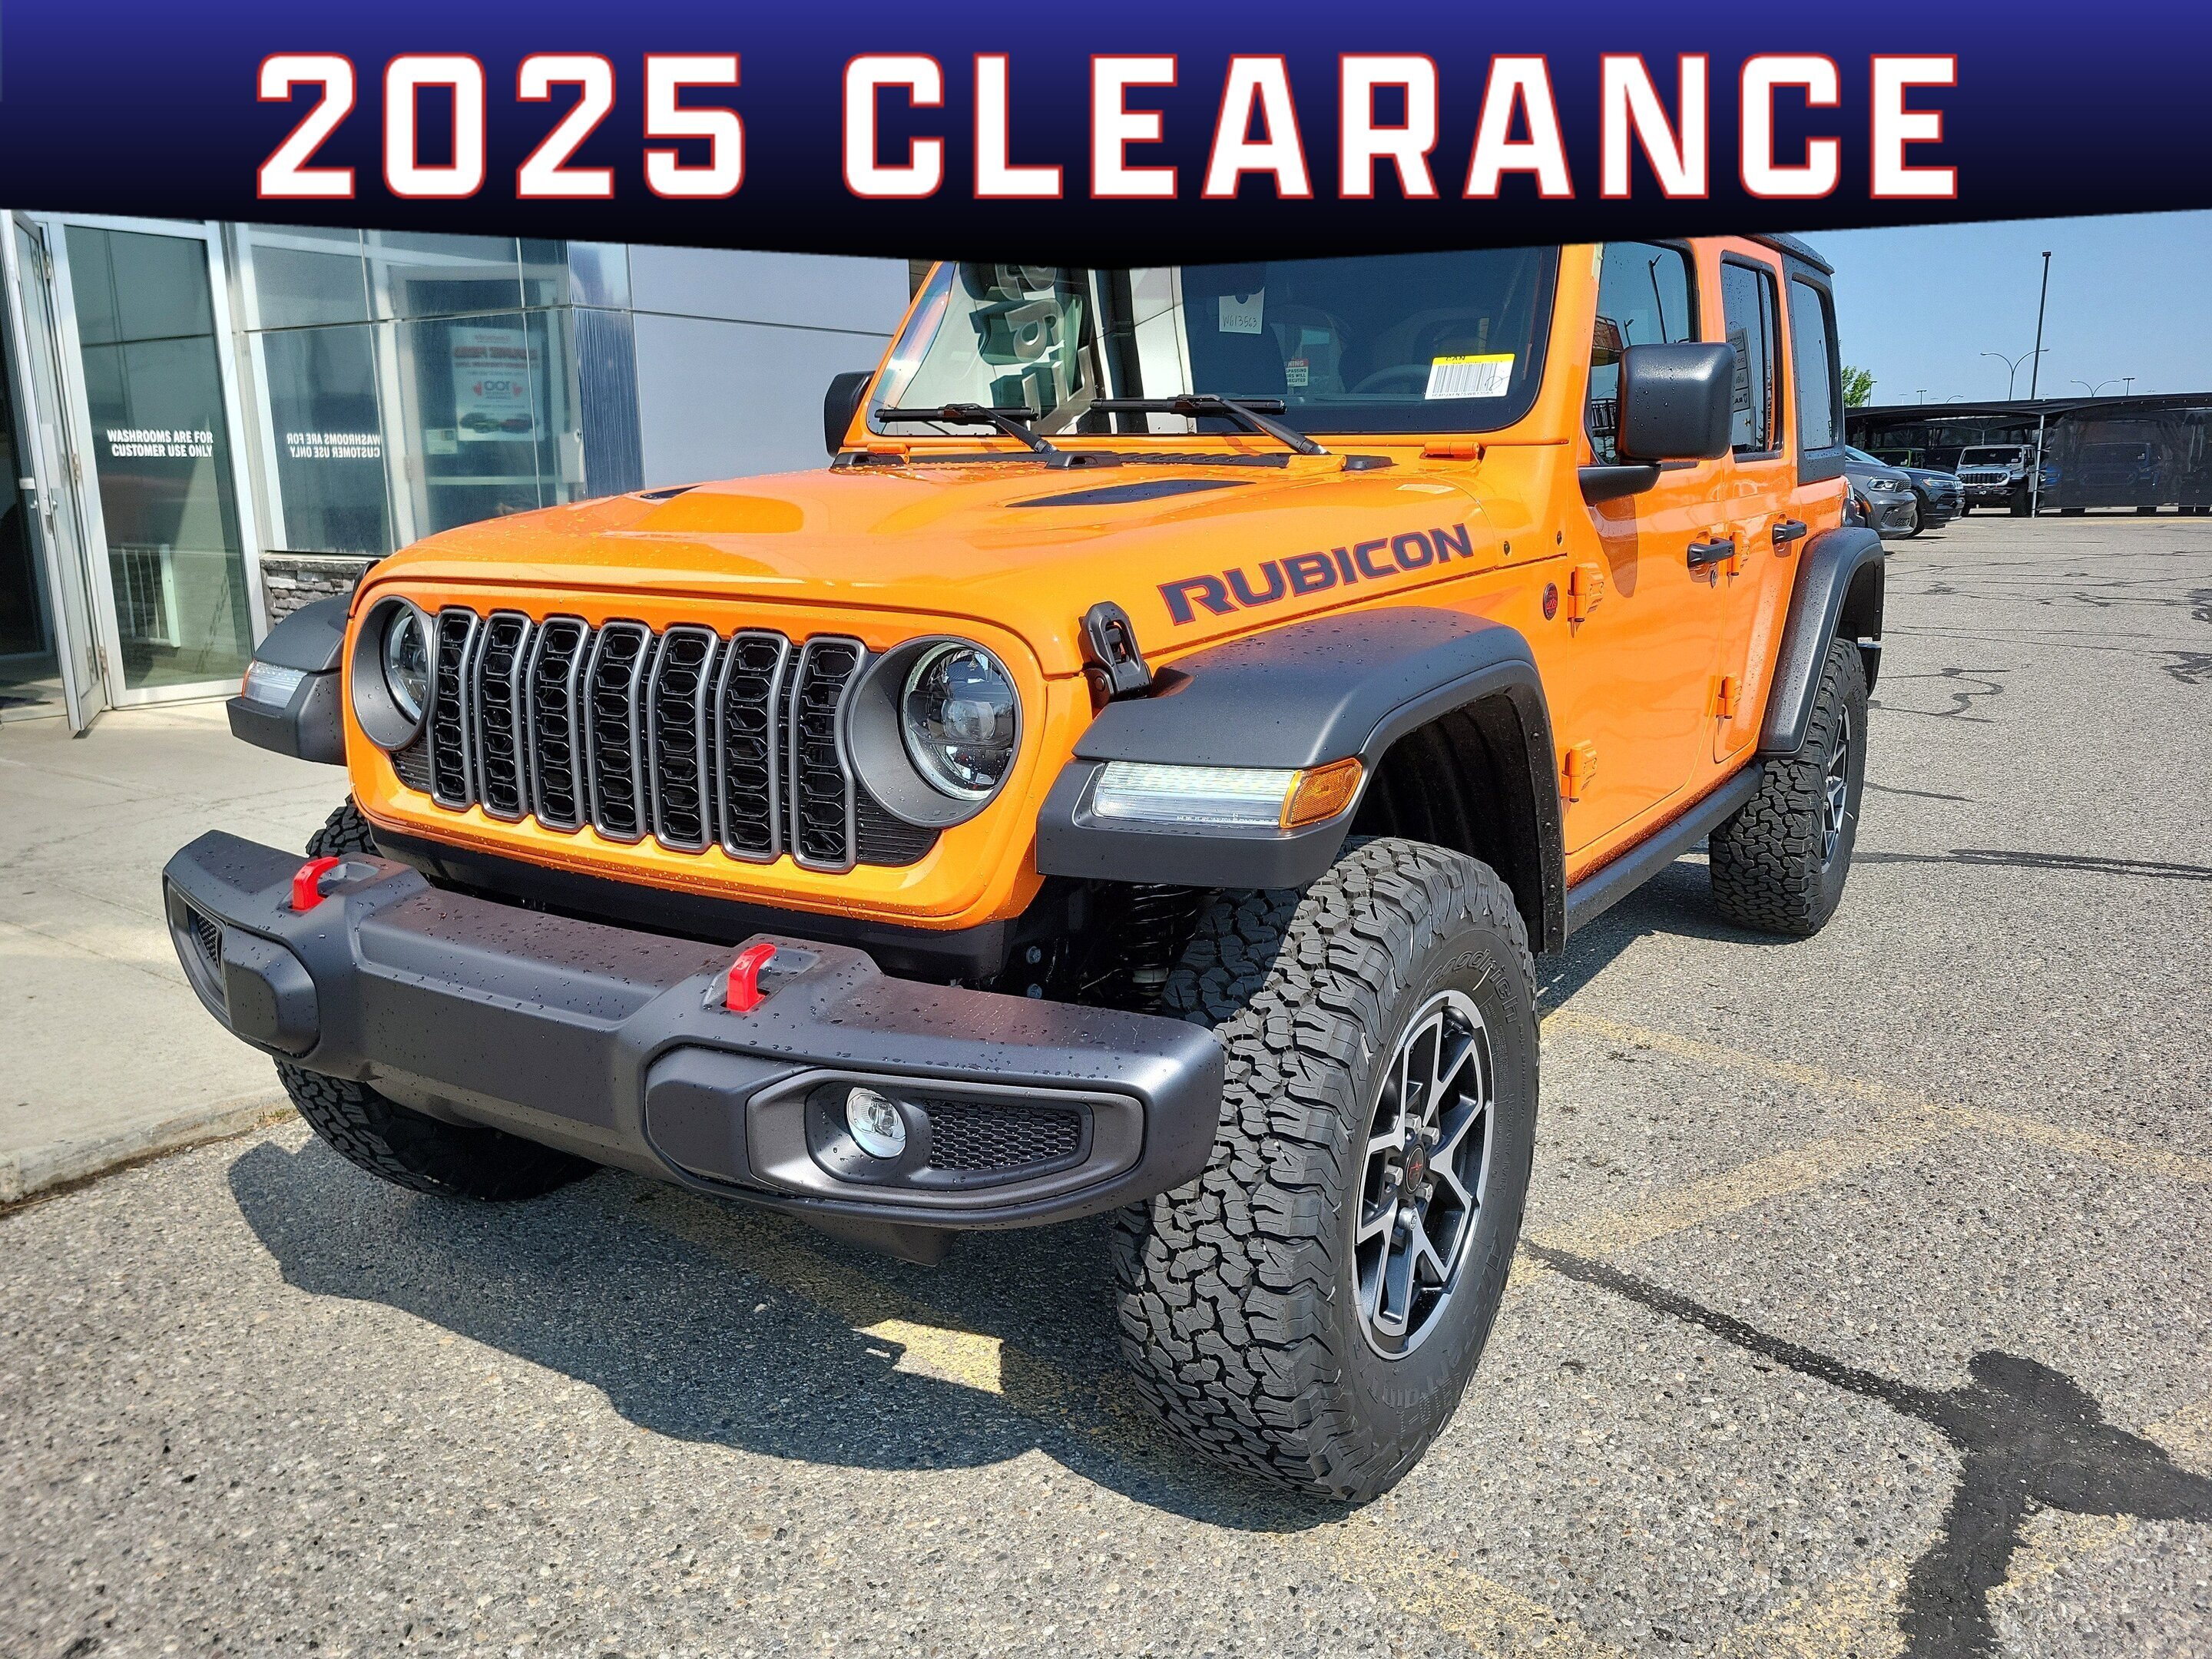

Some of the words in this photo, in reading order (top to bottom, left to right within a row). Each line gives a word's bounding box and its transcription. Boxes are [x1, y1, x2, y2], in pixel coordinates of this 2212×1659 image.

[107, 429, 172, 443] WASHROOMS
[174, 430, 193, 443] ARE
[194, 430, 214, 444] FOR
[111, 443, 166, 457] CUSTOMER
[167, 444, 187, 457] USE
[188, 444, 213, 457] ONLY
[1156, 522, 1475, 627] RUBICON
